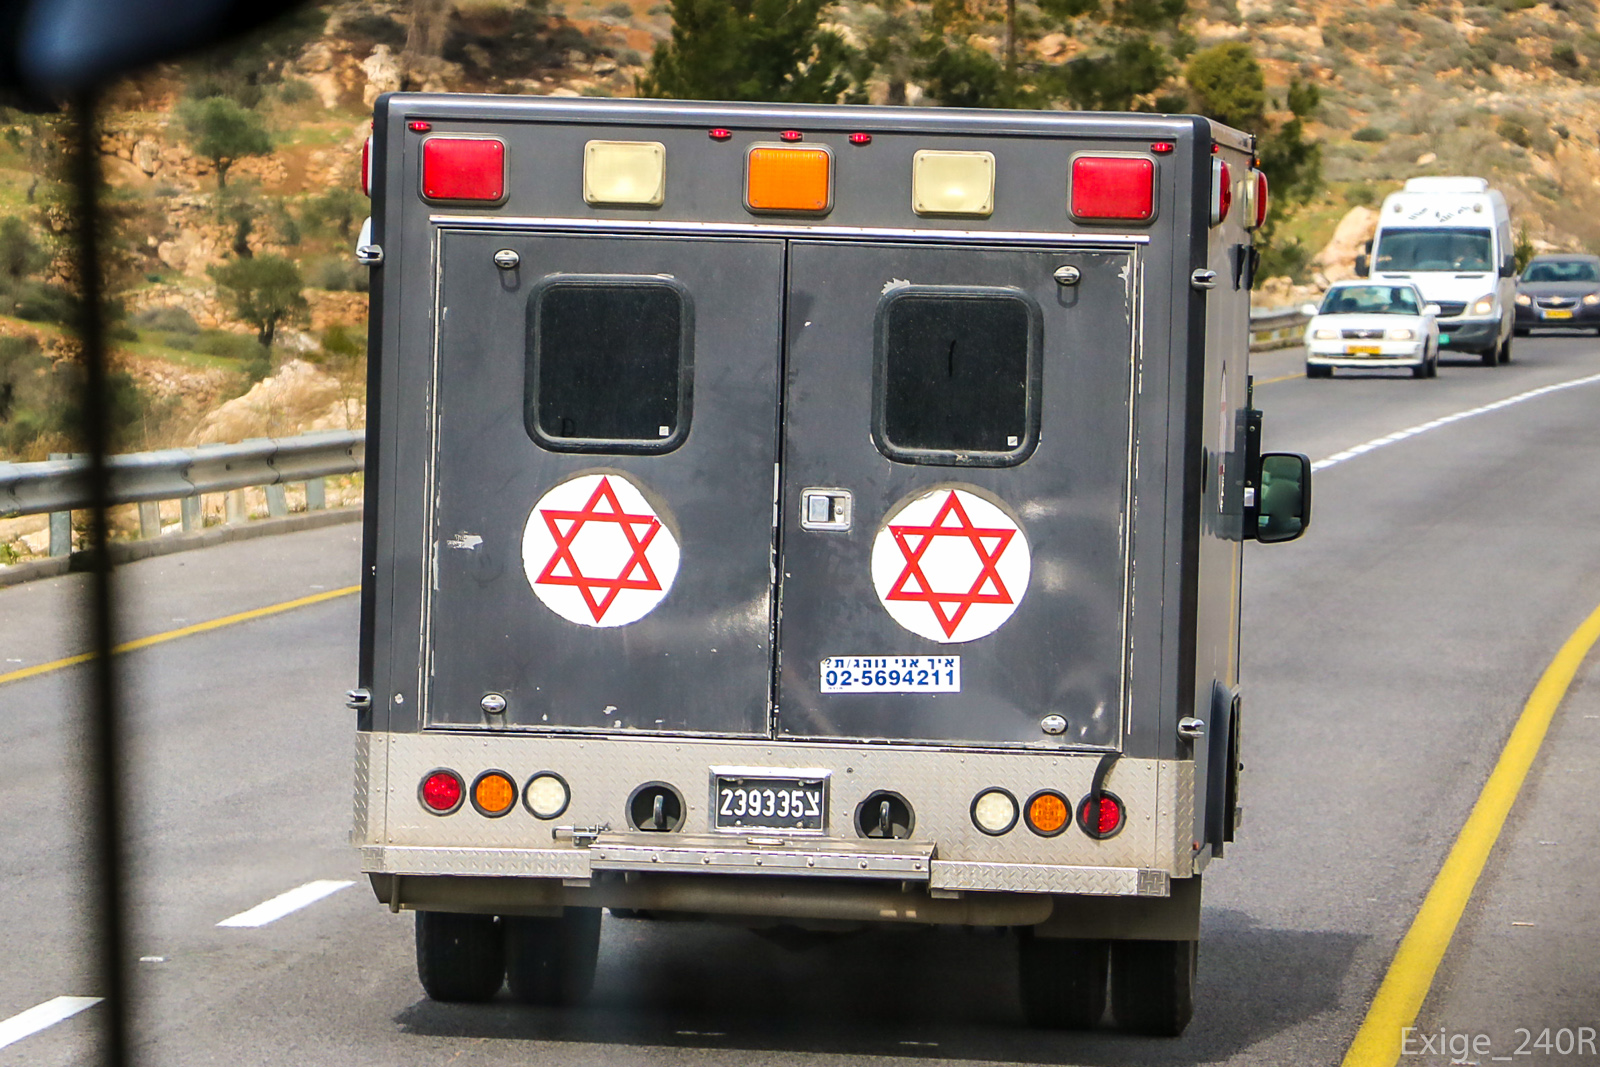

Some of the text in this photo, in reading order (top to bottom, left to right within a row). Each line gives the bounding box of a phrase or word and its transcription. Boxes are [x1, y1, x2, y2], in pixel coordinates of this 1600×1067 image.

[895, 658, 919, 668] אני
[928, 658, 955, 669] איך
[826, 670, 953, 686] 02-5694211
